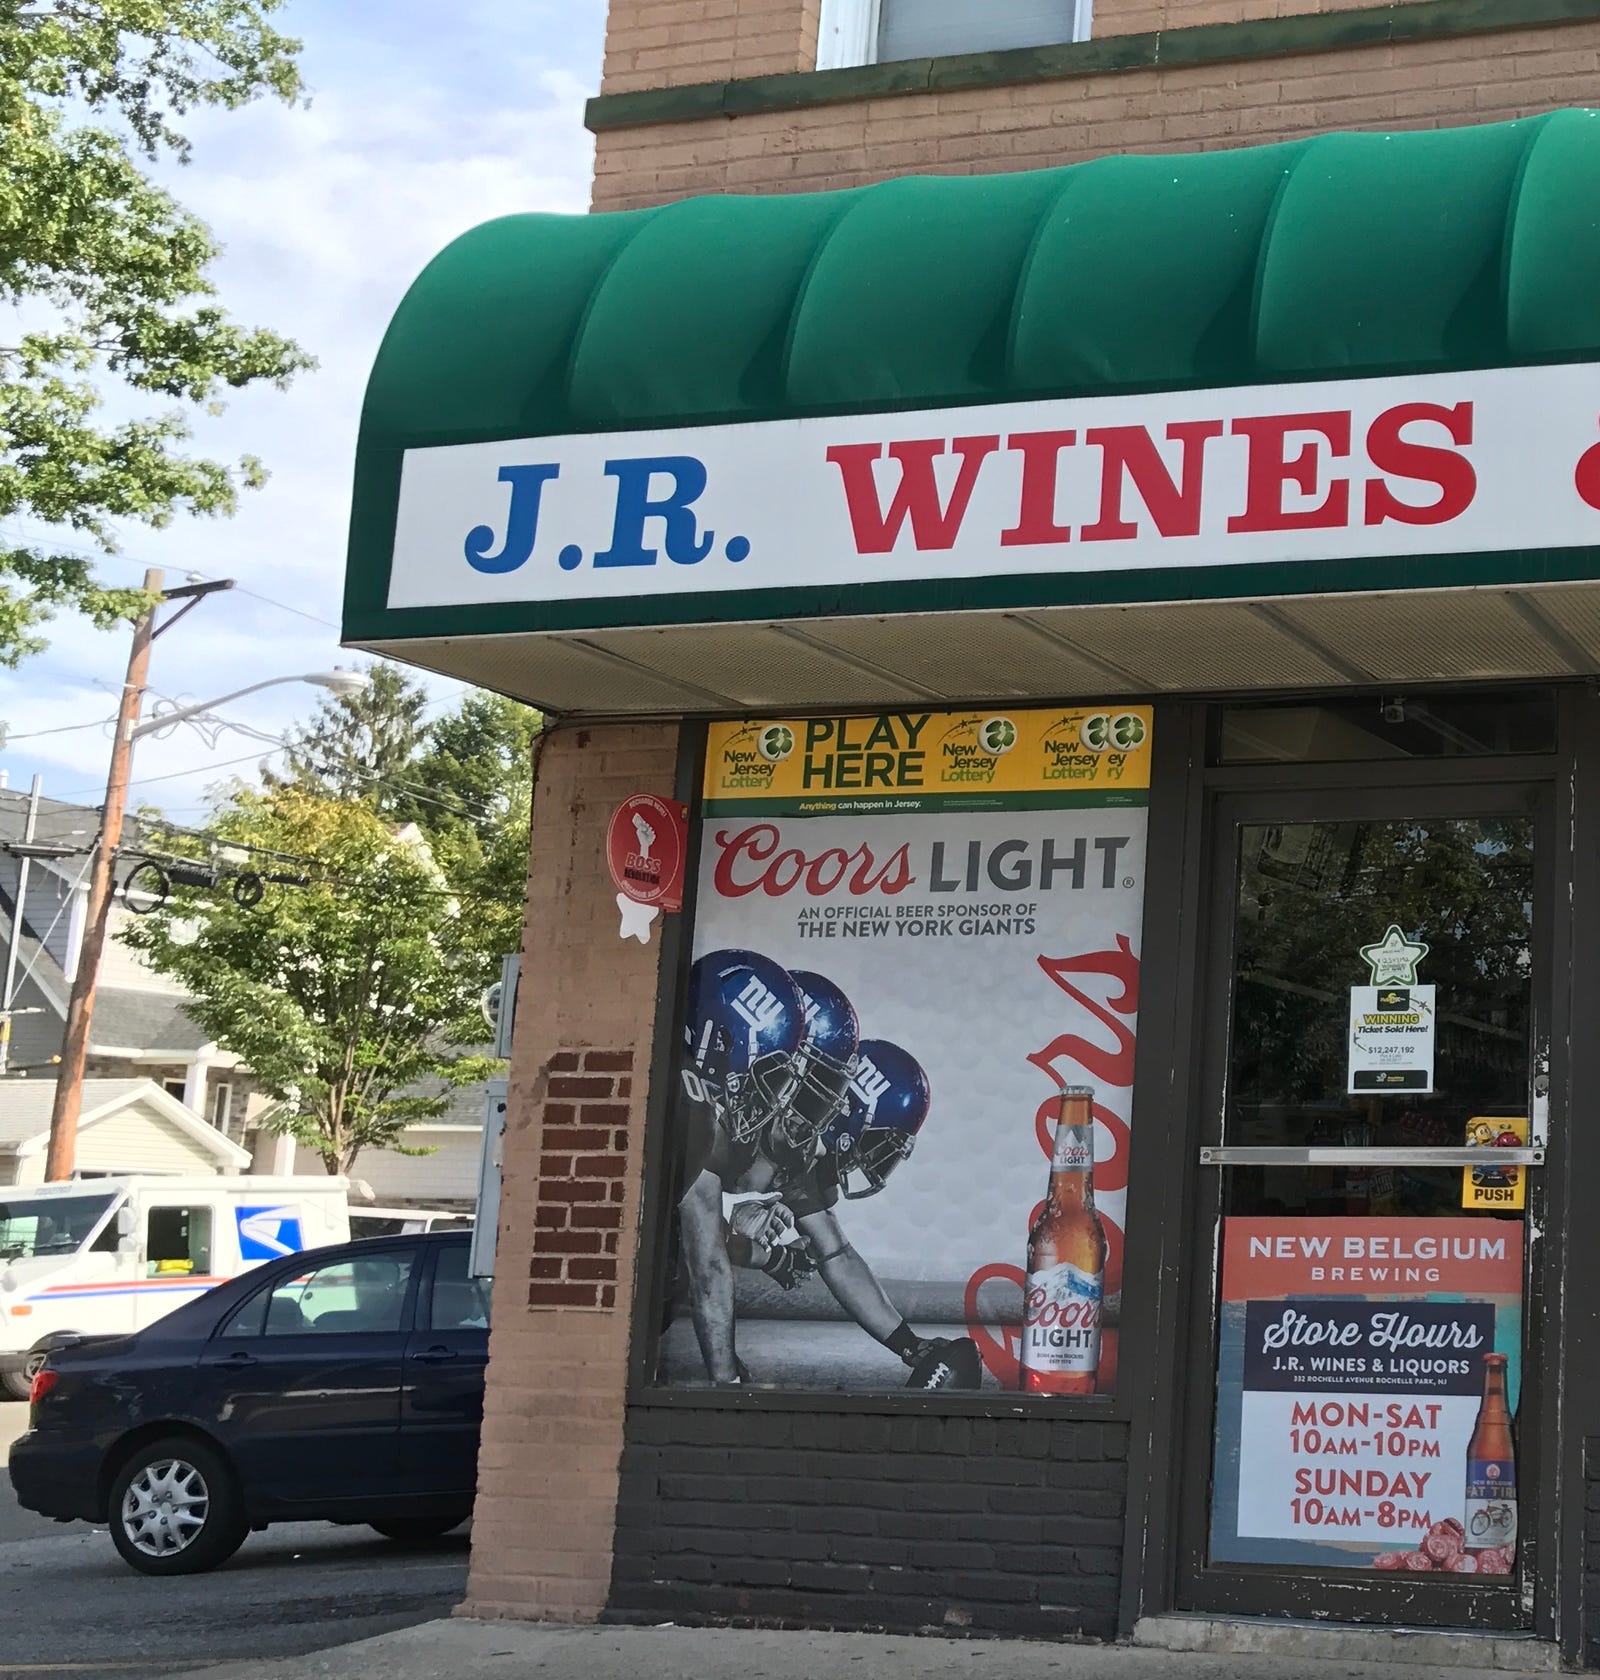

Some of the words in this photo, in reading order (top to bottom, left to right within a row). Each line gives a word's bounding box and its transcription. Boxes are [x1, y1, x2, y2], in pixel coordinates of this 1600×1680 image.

[464, 455, 751, 575] J.R.
[825, 400, 1477, 555] WINES
[804, 714, 931, 752] PLAY
[943, 743, 978, 756] New
[1044, 740, 1080, 753] New
[723, 750, 757, 763] New
[949, 756, 998, 770] Jersey
[1051, 753, 1100, 768] Jersey
[729, 763, 776, 777] Jersey
[802, 751, 926, 789] HERE
[940, 769, 996, 784] Lottery
[1042, 766, 1098, 781] Lottery
[721, 775, 774, 790] Lottery
[799, 802, 837, 811] Anything
[837, 802, 852, 810] can
[853, 801, 884, 810] happen
[624, 852, 663, 874] BOSS
[714, 823, 917, 897] Coors
[929, 836, 1131, 893] LIGHT
[798, 907, 820, 919] AN
[825, 904, 893, 918] OFFICIAL
[896, 904, 934, 917] BEER
[937, 903, 1012, 917] SPONSOR
[1015, 903, 1037, 915] OF
[798, 921, 838, 938] THE
[842, 921, 891, 938] NEW
[895, 920, 953, 937] YORK
[957, 919, 1036, 936] GIANTS
[1363, 1013, 1420, 1025] WINNING
[1358, 1026, 1383, 1034] Ticket
[1405, 1025, 1429, 1033] Here!
[1059, 1156, 1086, 1165] LIGHT
[1474, 1188, 1515, 1201] PUSH
[1250, 1236, 1331, 1258] NEW
[1344, 1236, 1505, 1260] BELGIUM
[1311, 1267, 1441, 1282] BREWING
[1263, 1309, 1362, 1353] Store
[1369, 1312, 1485, 1352] Hours
[1272, 1356, 1304, 1371] J.R.
[1310, 1357, 1366, 1373] WINES
[1372, 1358, 1384, 1373] &
[1390, 1358, 1470, 1375] LIQUORS
[1345, 1376, 1374, 1384] AVENUE
[1415, 1378, 1437, 1386] PARK,
[1290, 1401, 1443, 1430] MON-SAT
[1289, 1429, 1442, 1458] 10AM-10PM
[1294, 1468, 1432, 1499] SUNDAY
[1467, 1486, 1486, 1498] FAT
[1290, 1498, 1432, 1529] 10AM-8PM
